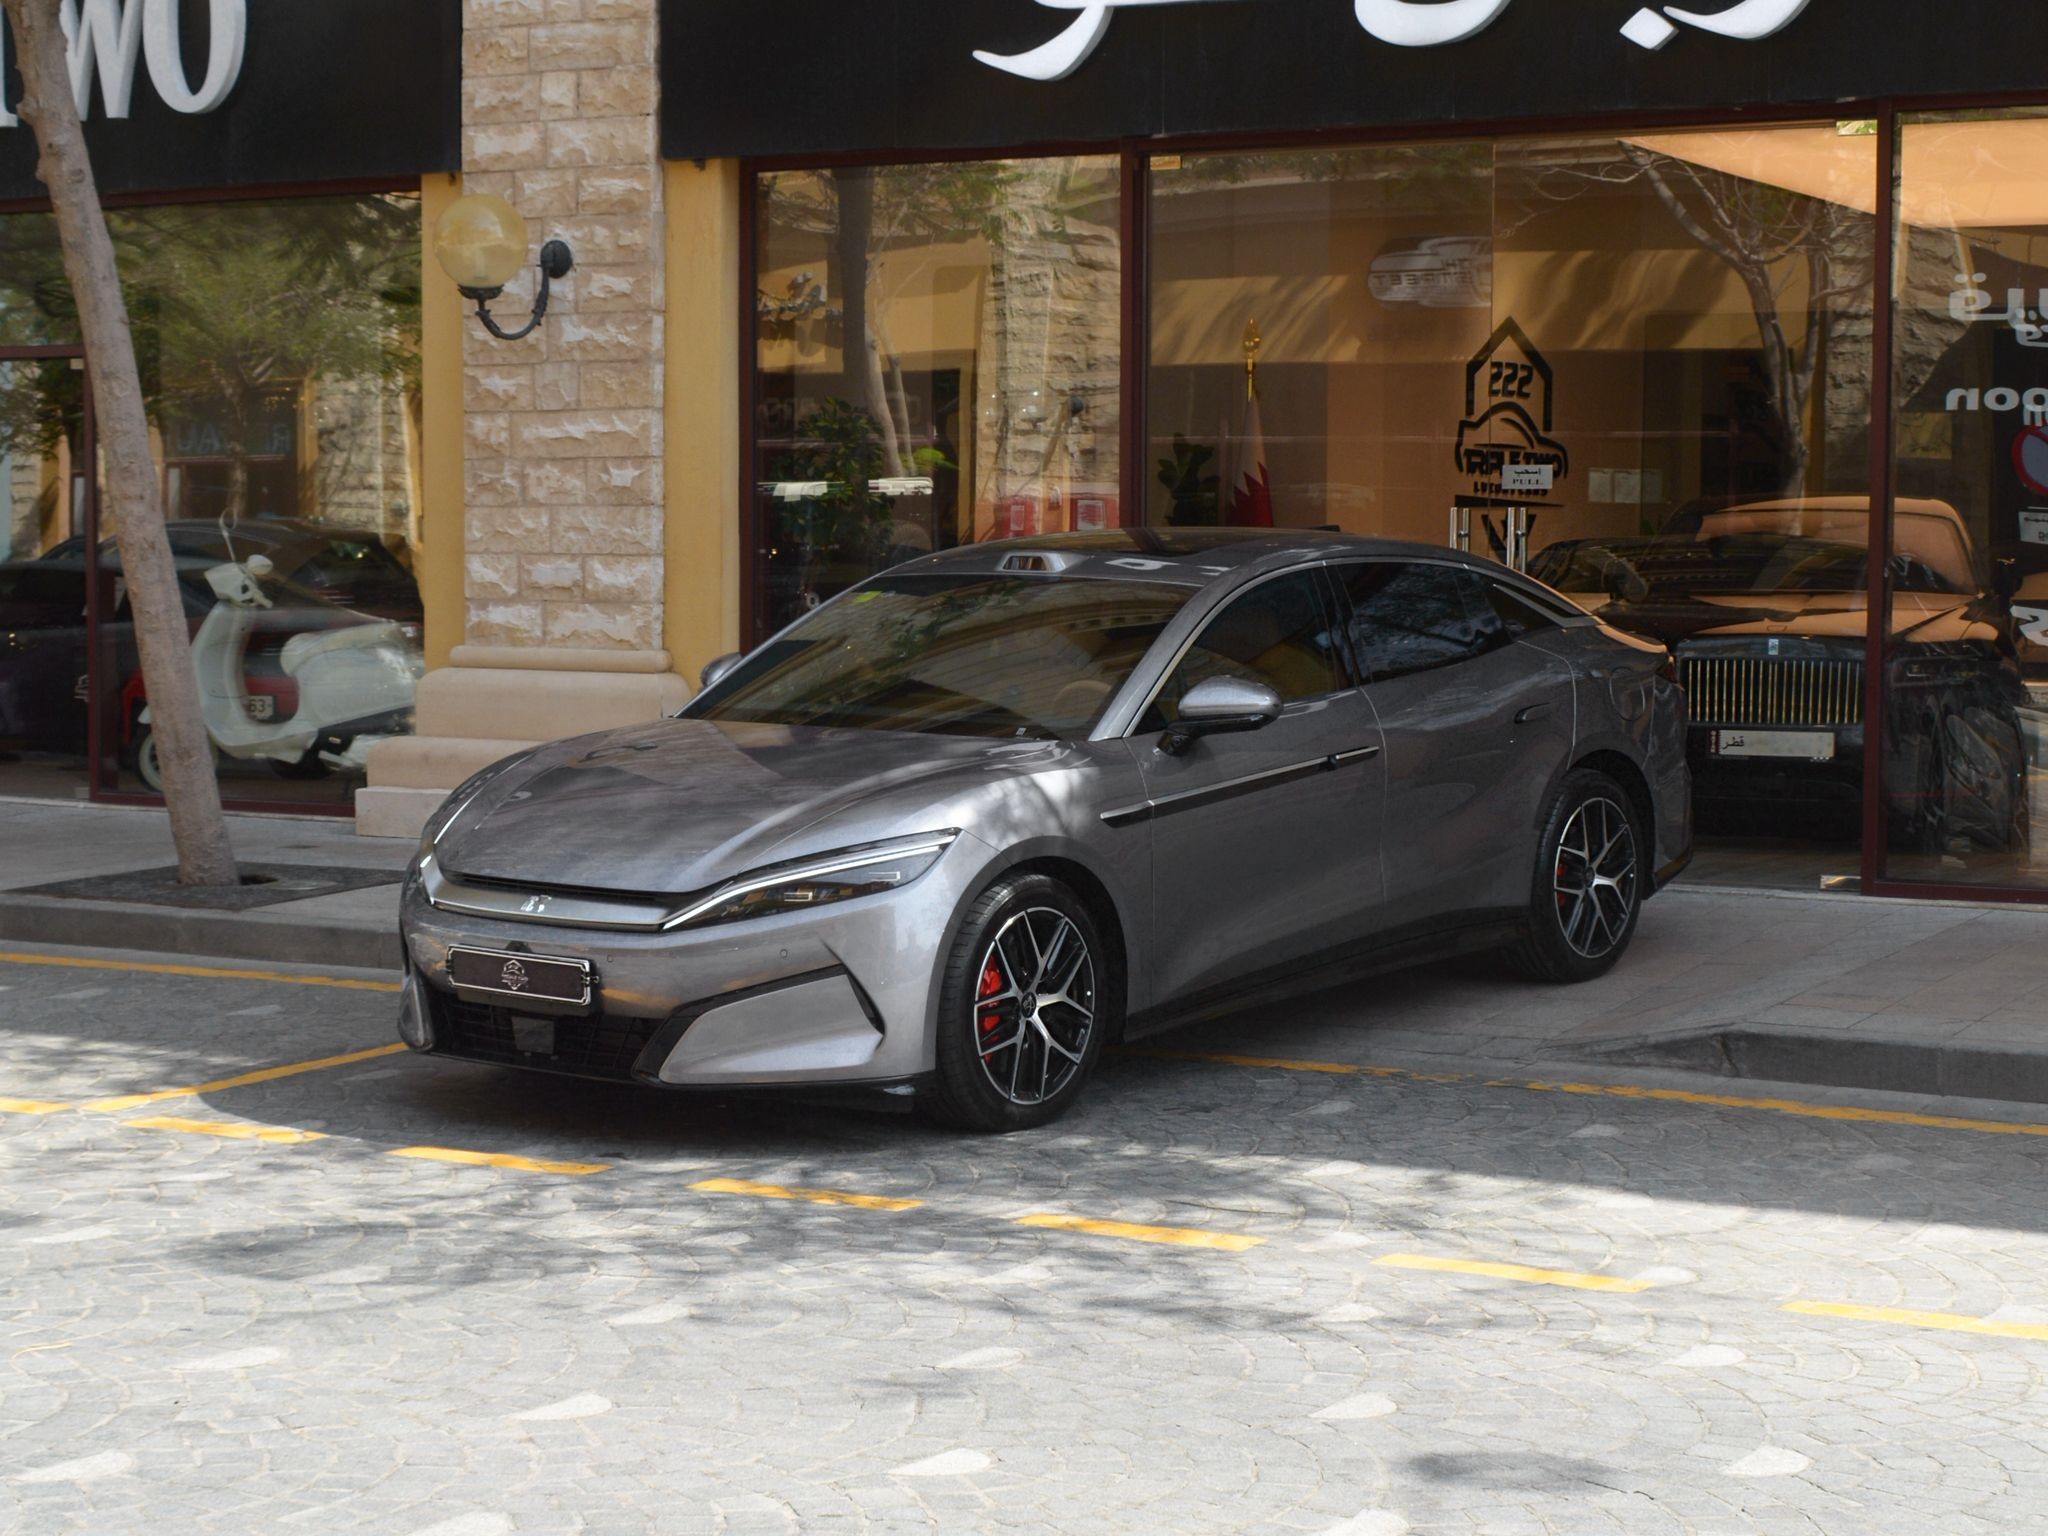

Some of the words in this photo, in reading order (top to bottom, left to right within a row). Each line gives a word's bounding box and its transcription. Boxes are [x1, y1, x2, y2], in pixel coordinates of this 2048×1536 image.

[0, 0, 247, 127] WO
[1488, 361, 1534, 398] 222
[1513, 478, 1544, 486] PULL
